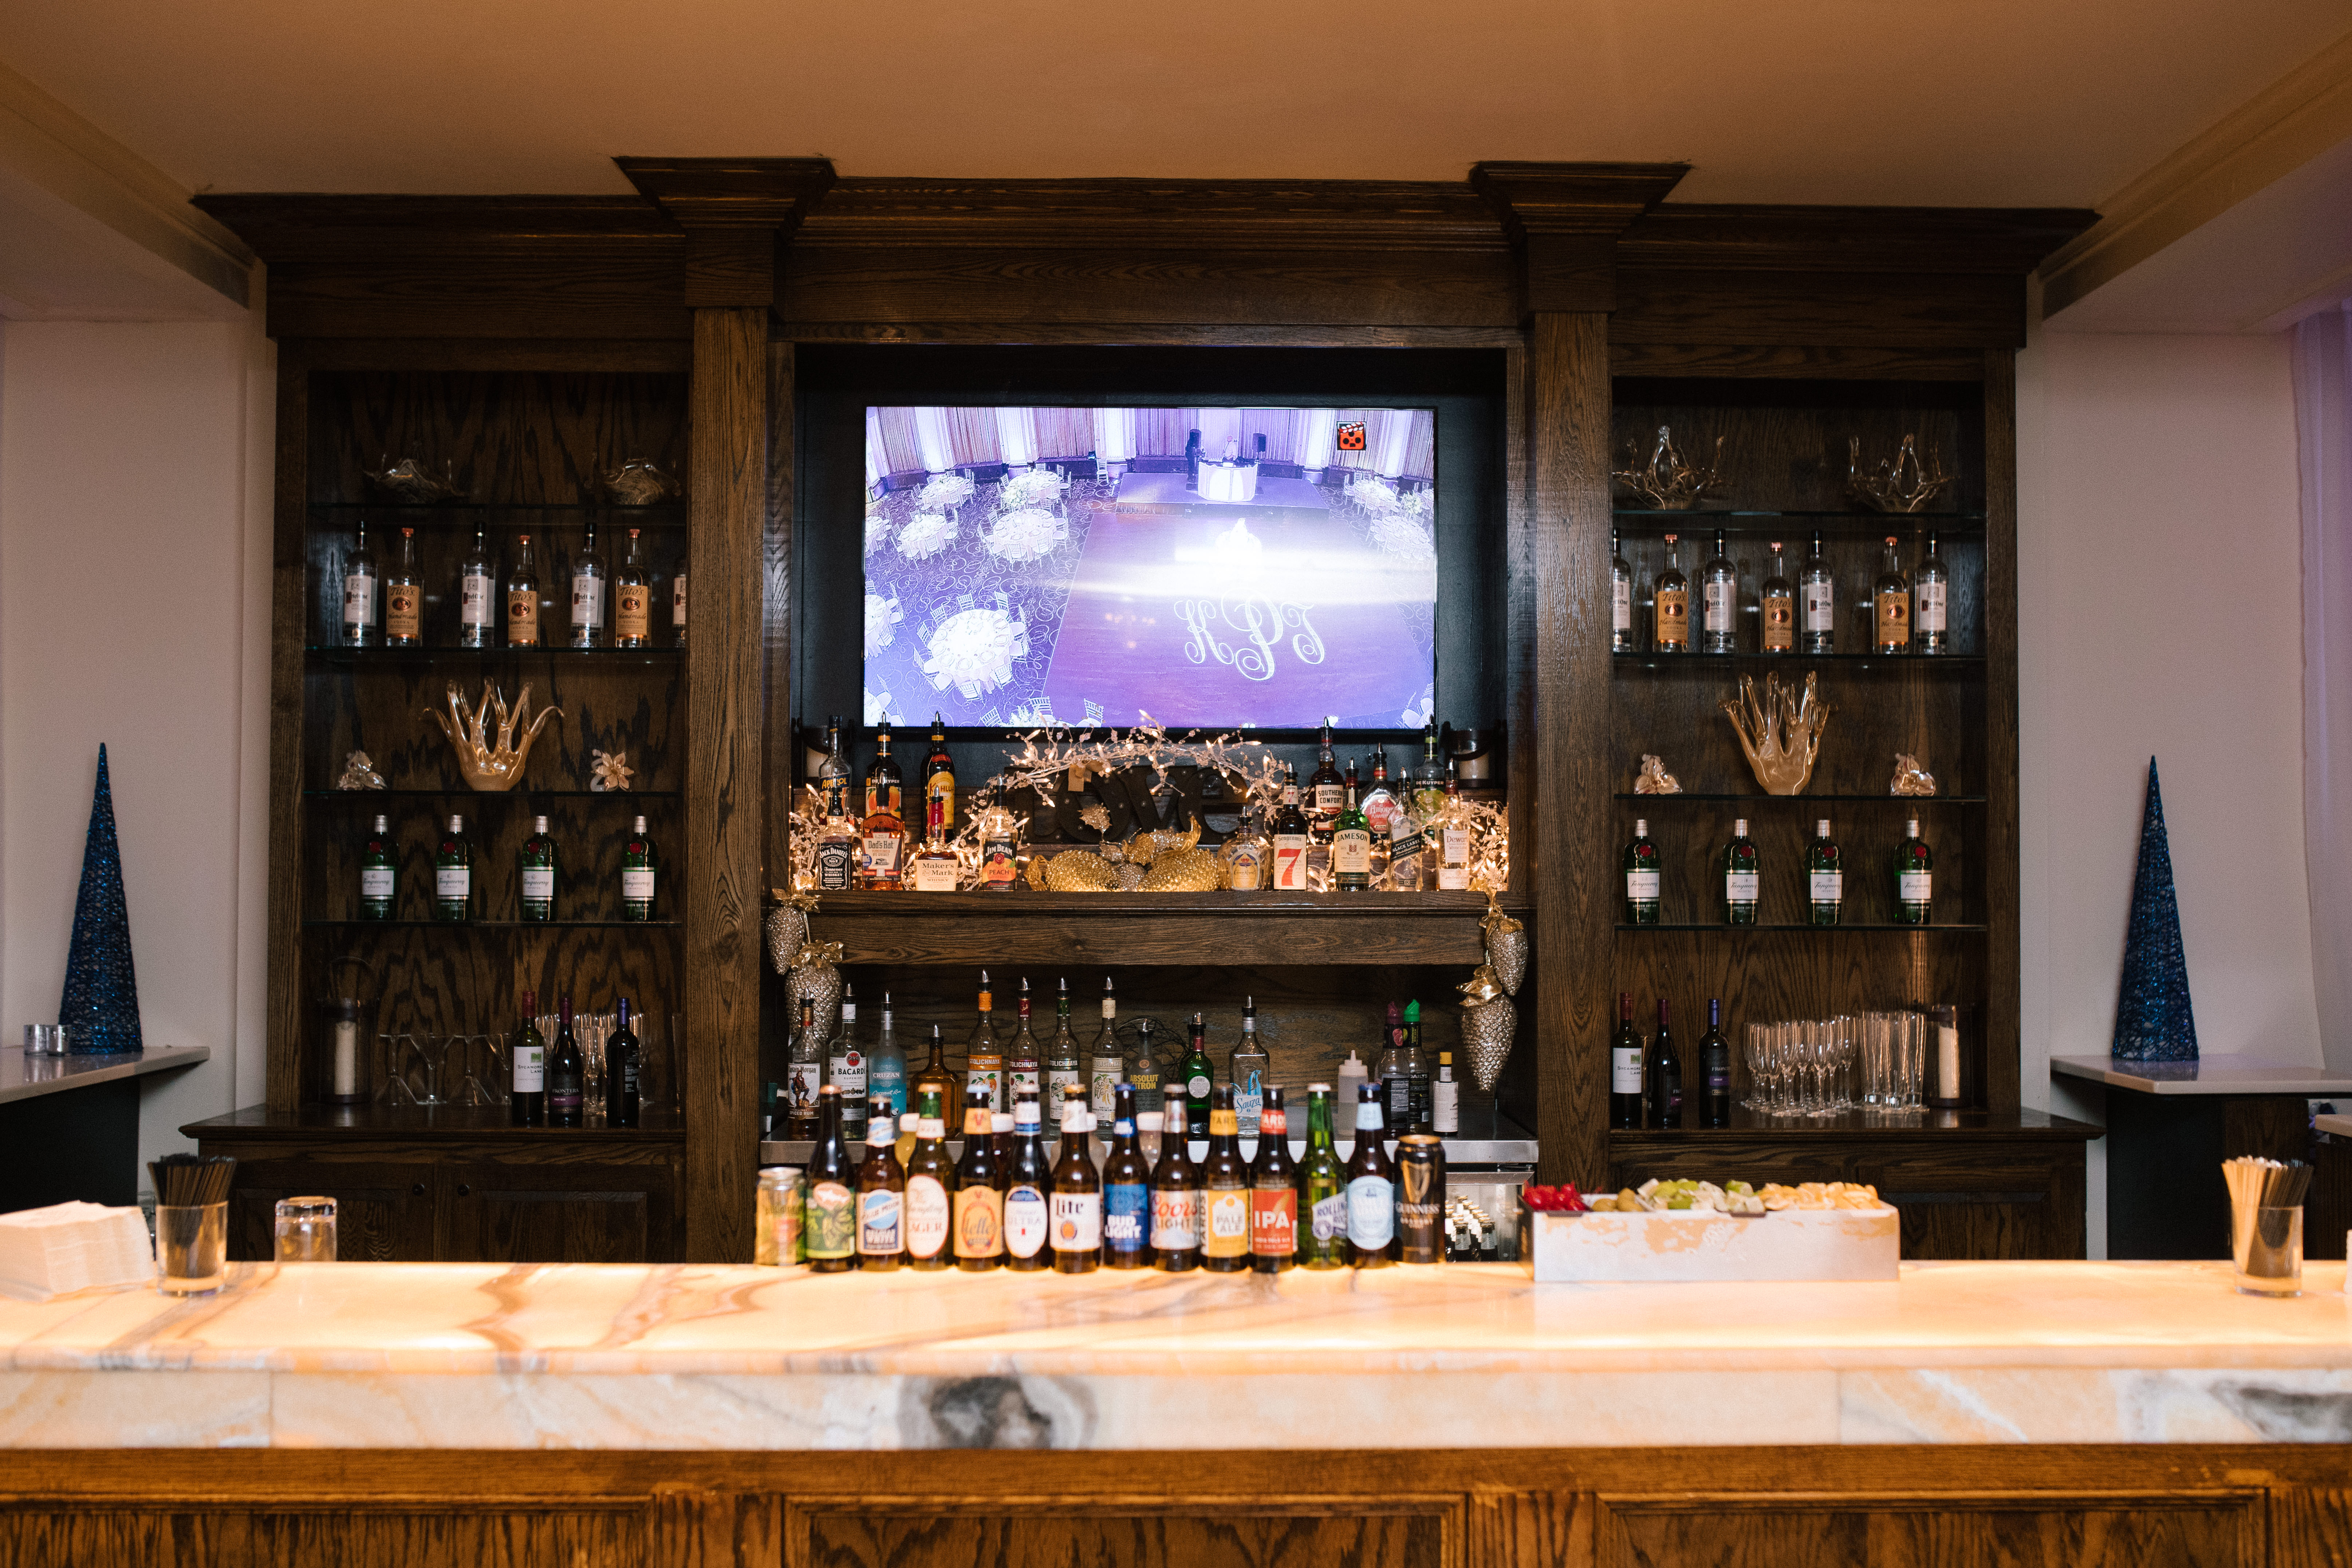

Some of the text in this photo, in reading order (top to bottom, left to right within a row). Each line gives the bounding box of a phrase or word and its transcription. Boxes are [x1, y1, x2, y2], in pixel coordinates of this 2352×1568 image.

[391, 587, 415, 596] Tito's
[510, 593, 533, 601] Tito's
[620, 587, 644, 596] Tito's
[1663, 593, 1686, 601] Tito's
[1769, 599, 1791, 608] Tito's
[1884, 595, 1906, 603] Tito's
[930, 783, 954, 795] KHLÚA
[1287, 792, 1294, 803] 7
[1337, 833, 1368, 842] JAMESON
[868, 840, 894, 848] Dad's Hat
[1392, 844, 1406, 852] BLACK
[819, 847, 848, 859] JACK DANIEL'S
[985, 844, 1012, 856] JIM BEAM
[1277, 848, 1302, 886] 7
[1235, 1098, 1261, 1114] Sauza
[1056, 1199, 1083, 1218] Lite
[1151, 1194, 1197, 1217] Coors
[1396, 1203, 1440, 1214] GUINNESS
[1107, 1214, 1136, 1226] BUD
[1157, 1218, 1190, 1229] LIGHT
[1254, 1210, 1290, 1229] IPA
[1105, 1225, 1142, 1238] LIGHT
[1220, 1224, 1240, 1232] ALE
